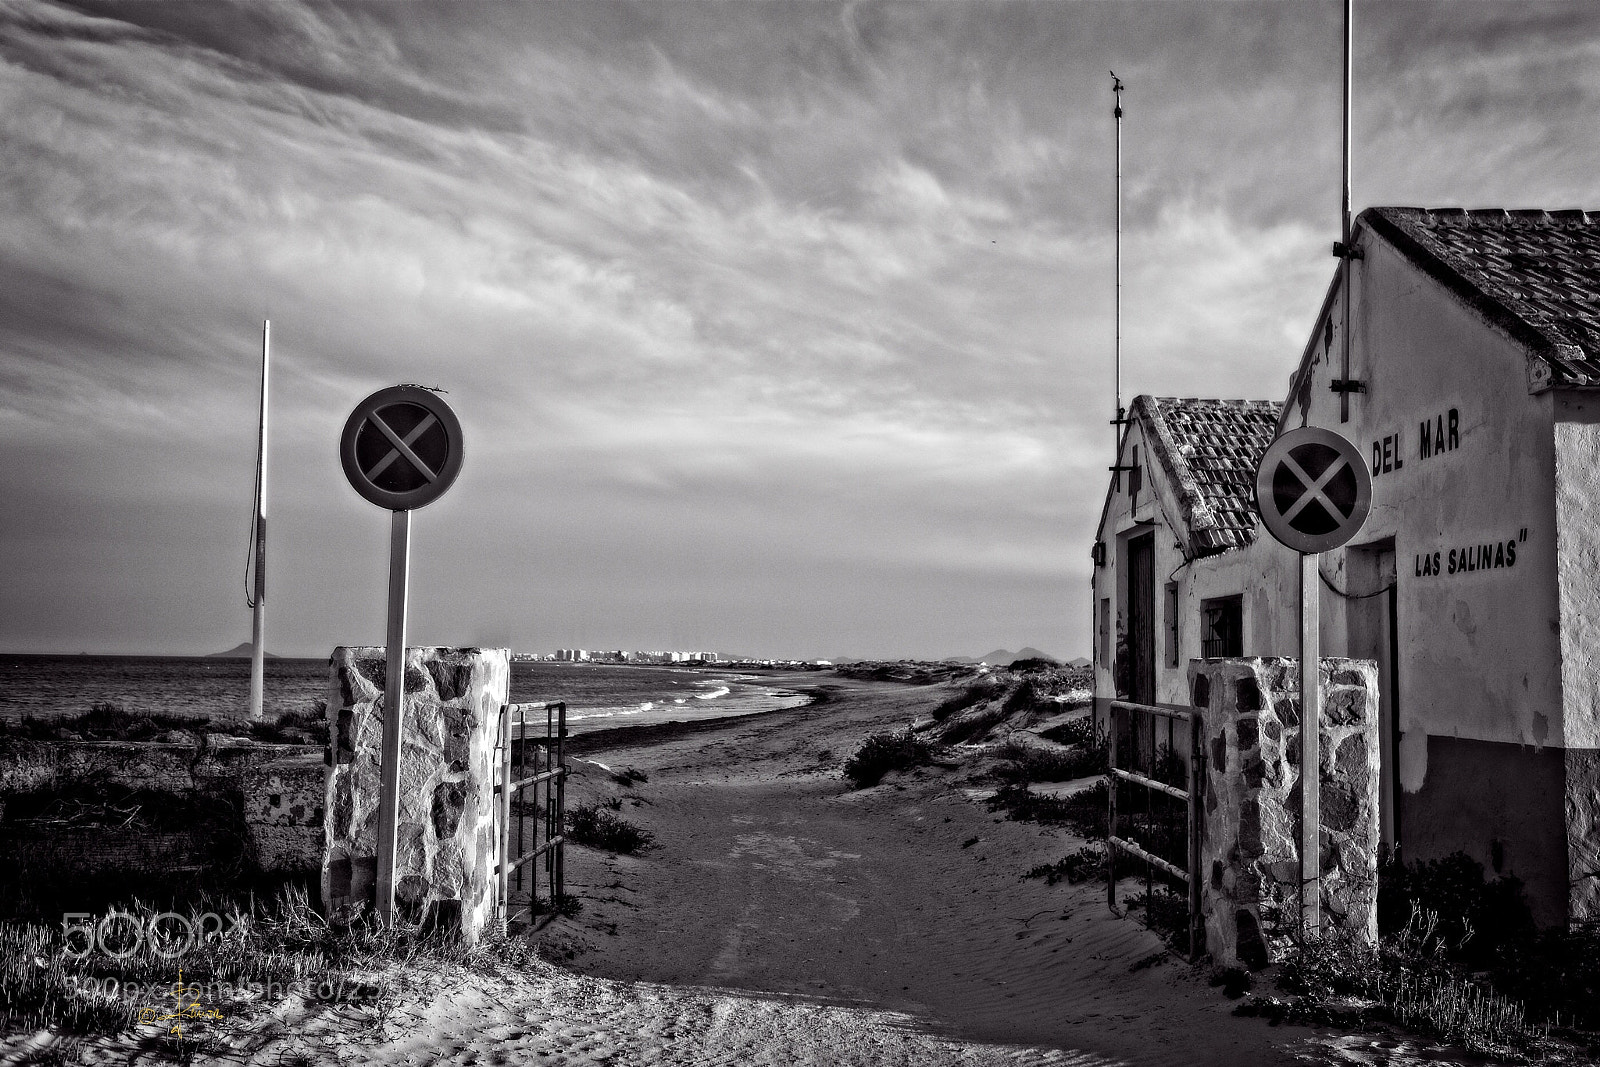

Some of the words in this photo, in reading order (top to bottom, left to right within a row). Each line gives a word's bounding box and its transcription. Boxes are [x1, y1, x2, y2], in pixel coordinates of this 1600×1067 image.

[1372, 433, 1403, 477] DEL
[1420, 408, 1459, 460] MAR
[1415, 552, 1441, 577] LAS
